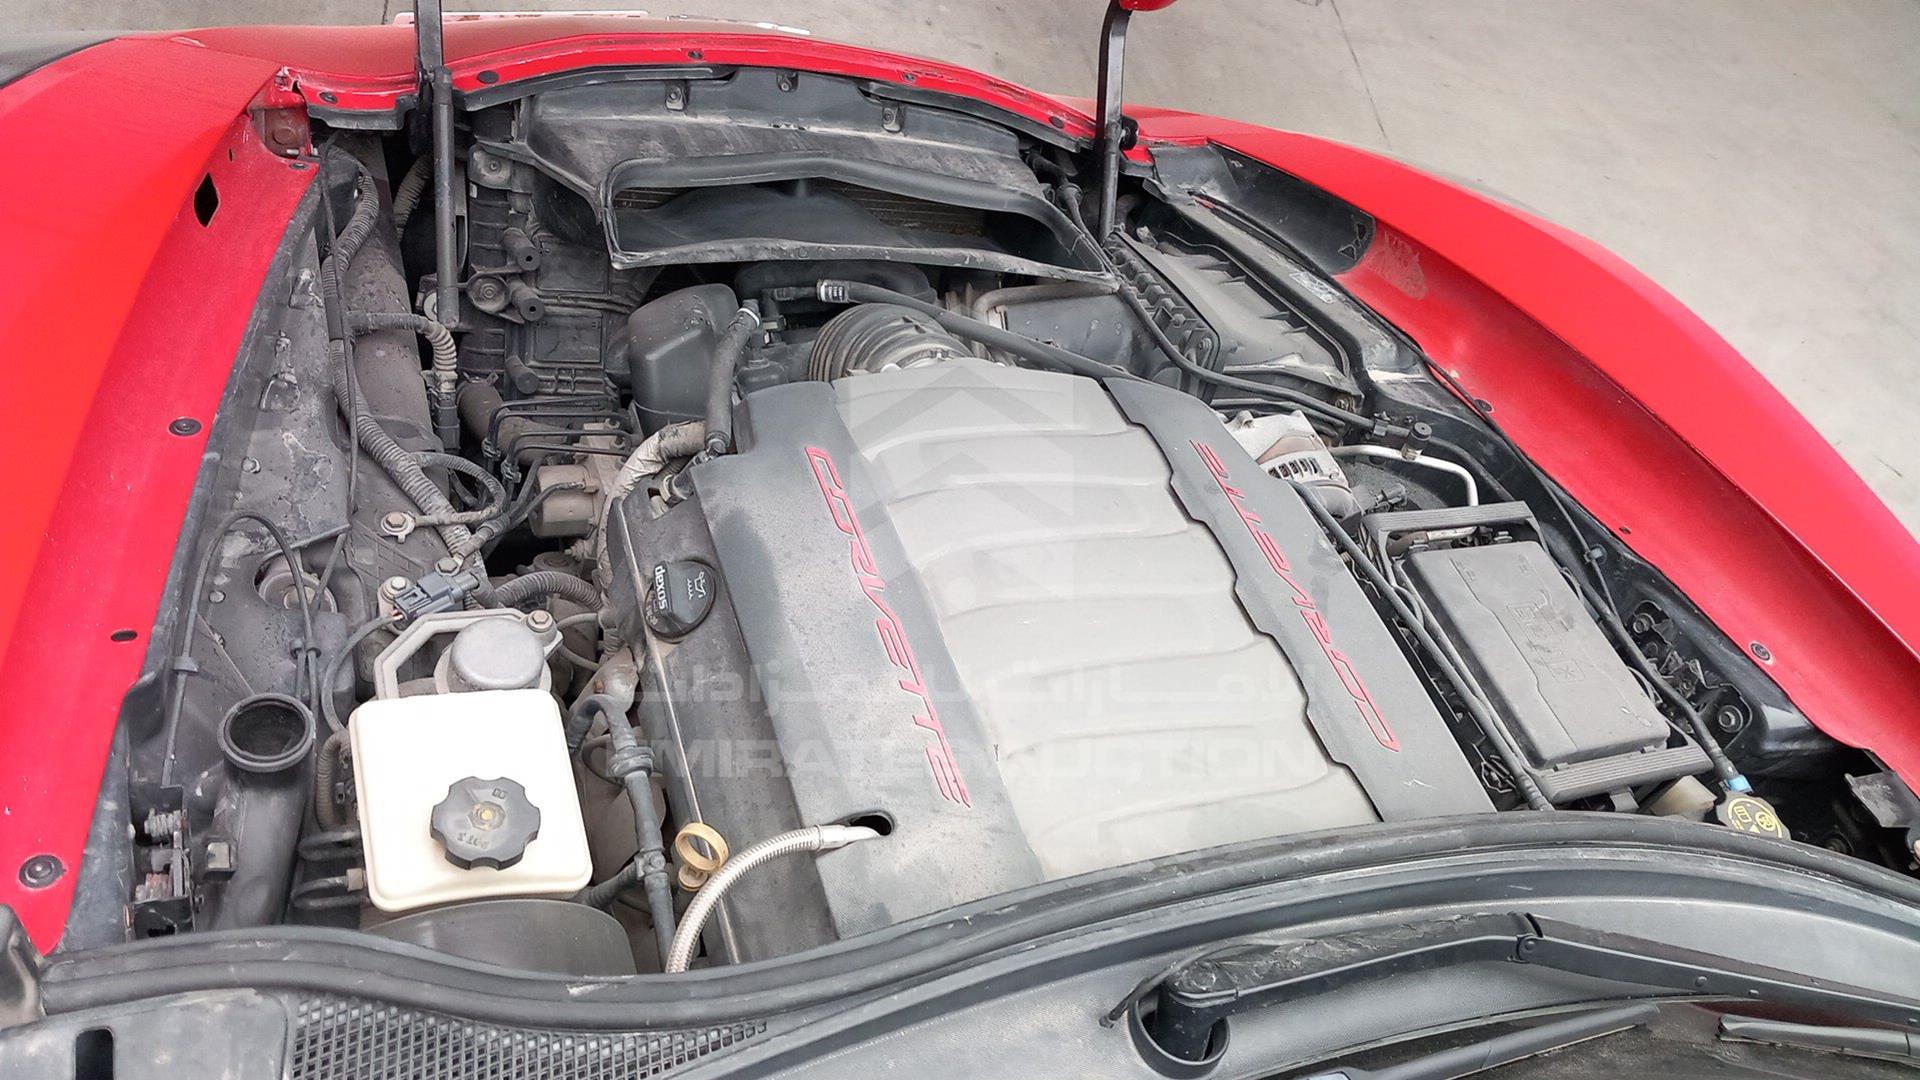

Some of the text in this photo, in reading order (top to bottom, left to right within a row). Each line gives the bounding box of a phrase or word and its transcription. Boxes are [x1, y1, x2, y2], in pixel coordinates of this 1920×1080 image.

[653, 565, 668, 611] dexos
[804, 446, 972, 809] CORVETTE
[1188, 438, 1402, 753] CORVETTE
